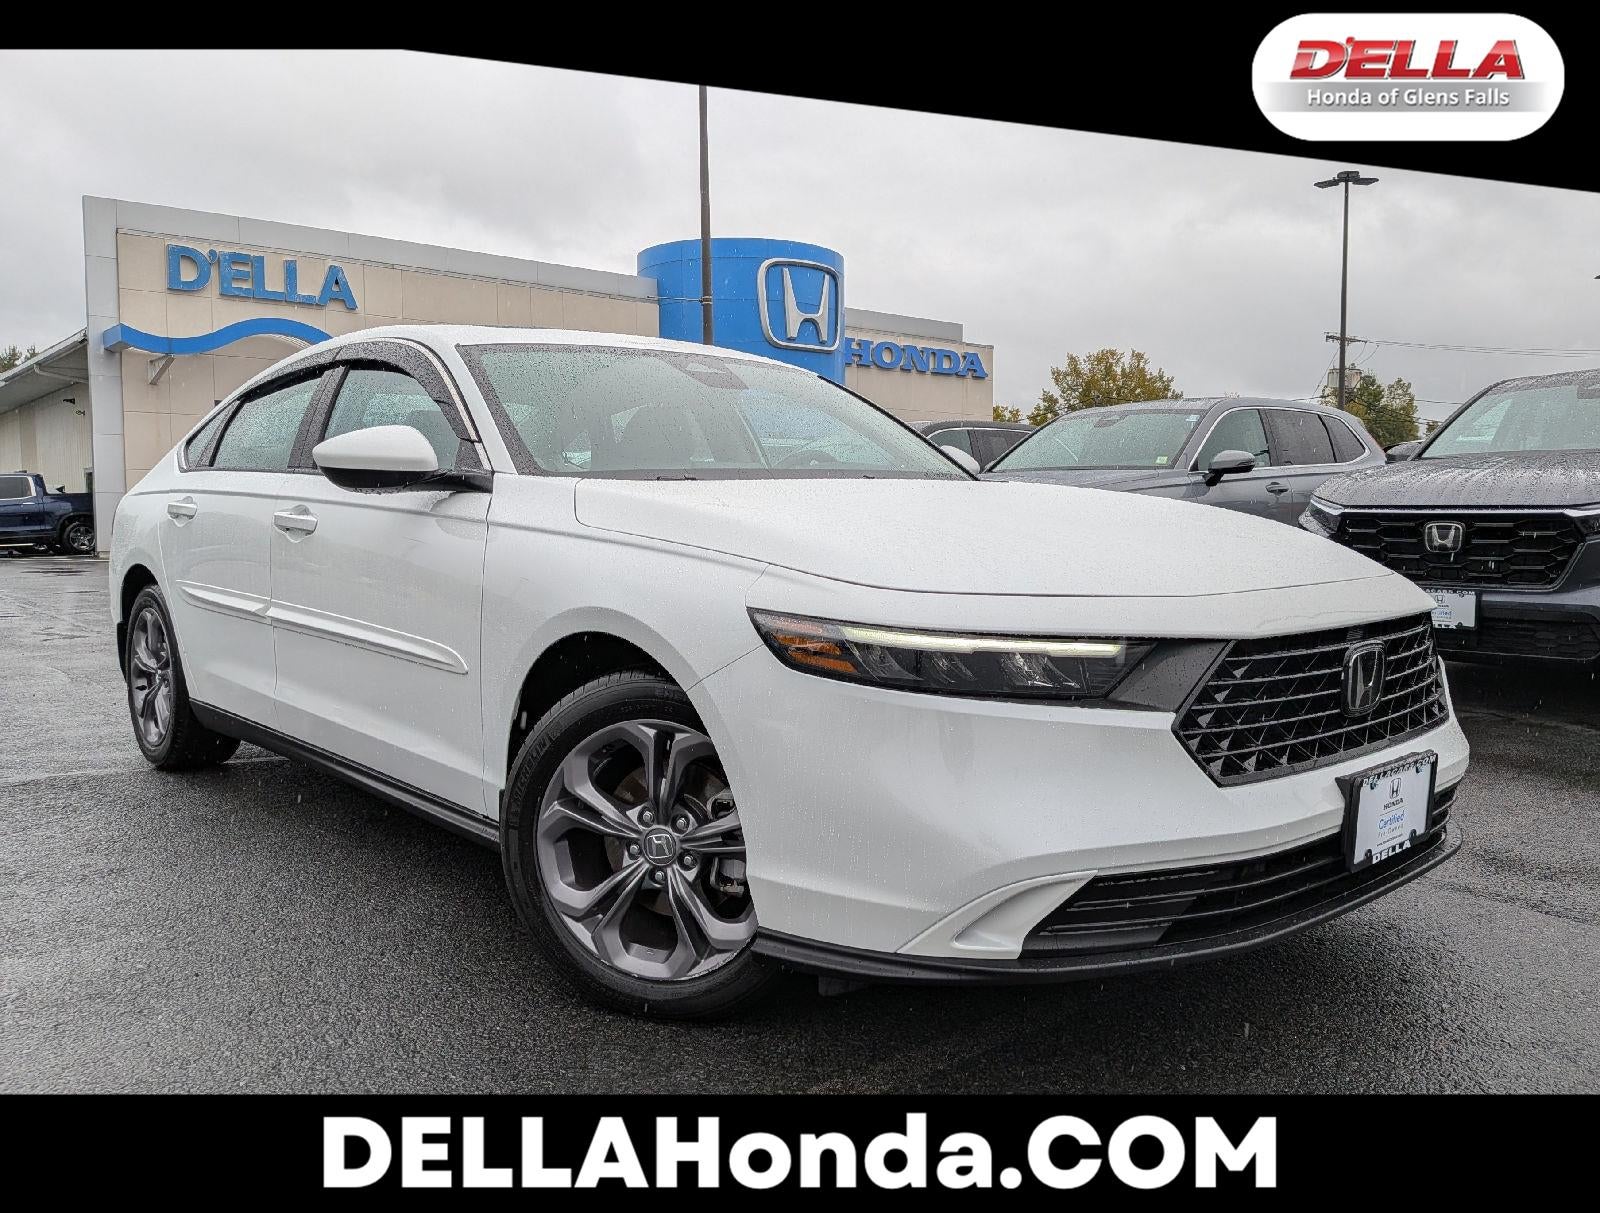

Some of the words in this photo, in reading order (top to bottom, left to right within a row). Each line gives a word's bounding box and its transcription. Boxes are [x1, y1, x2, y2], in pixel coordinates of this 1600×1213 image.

[167, 243, 358, 311] D'ELLA
[845, 337, 988, 379] HONDA
[1383, 798, 1404, 811] HONDA
[1378, 810, 1405, 830] Certified
[1372, 839, 1412, 864] DELLA
